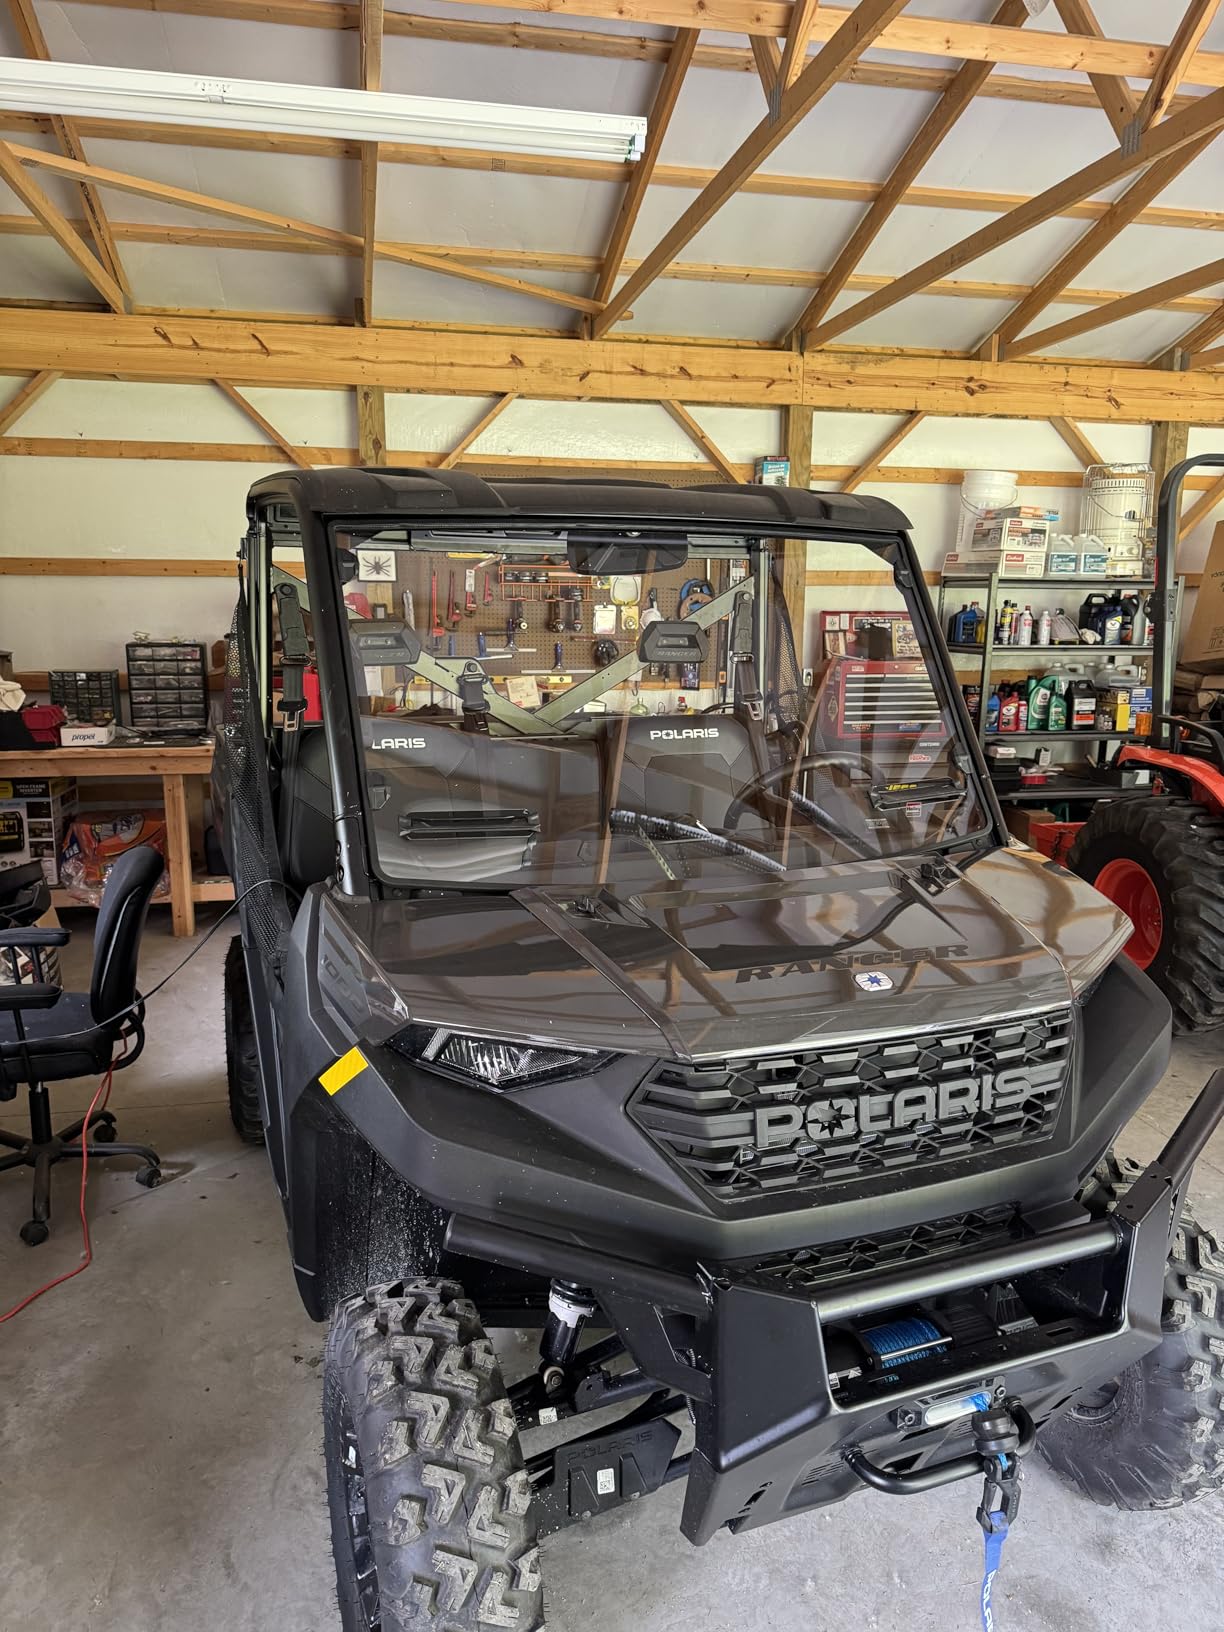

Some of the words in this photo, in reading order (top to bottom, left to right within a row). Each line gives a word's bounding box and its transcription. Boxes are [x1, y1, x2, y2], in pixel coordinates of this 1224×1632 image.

[649, 727, 720, 741] POLARIS
[735, 944, 969, 984] RANGER
[754, 1069, 1033, 1148] POLARIS
[566, 1429, 655, 1464] POLARIS
